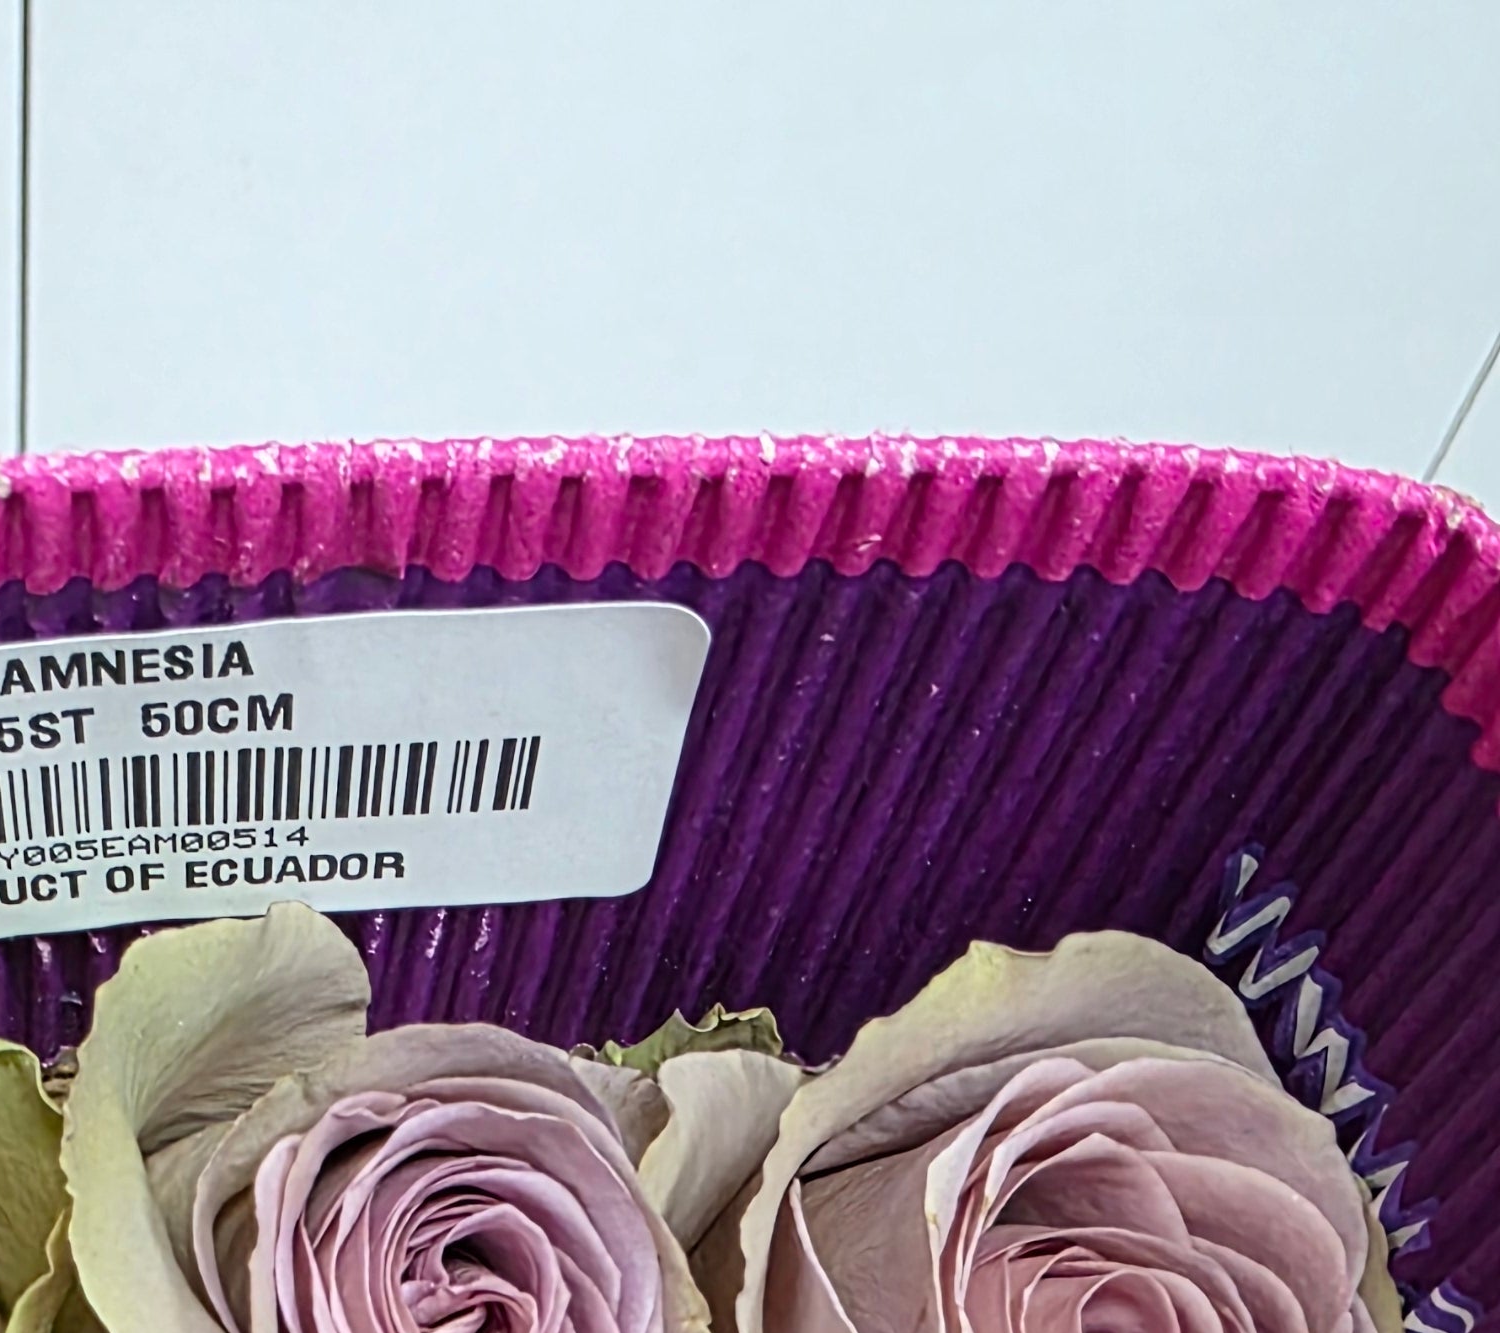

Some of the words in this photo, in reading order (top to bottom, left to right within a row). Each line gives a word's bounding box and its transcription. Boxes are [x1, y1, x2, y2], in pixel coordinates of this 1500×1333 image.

[0, 640, 255, 697] AMNESIA
[140, 693, 295, 739] 50CM
[105, 862, 165, 894] OF
[184, 850, 406, 889] ECUADOR
